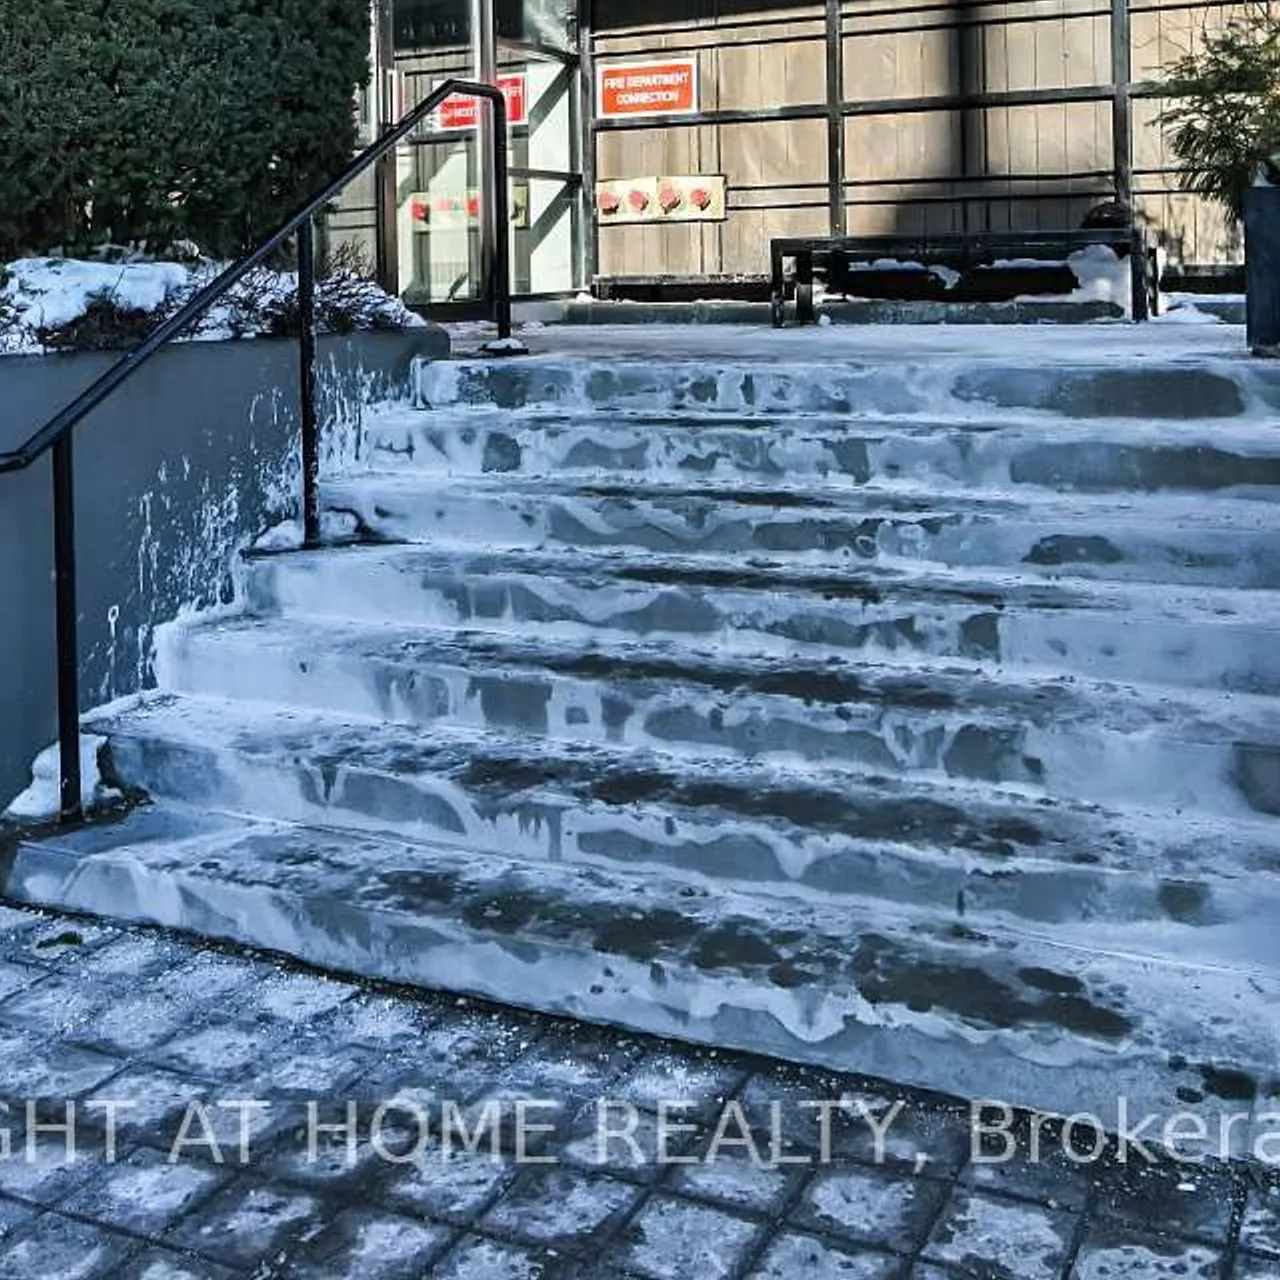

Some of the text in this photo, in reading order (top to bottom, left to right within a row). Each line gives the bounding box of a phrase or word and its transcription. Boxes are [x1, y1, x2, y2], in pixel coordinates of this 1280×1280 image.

[604, 72, 689, 89] FIRE DEPARTMENT
[616, 90, 680, 105] CONNECTION
